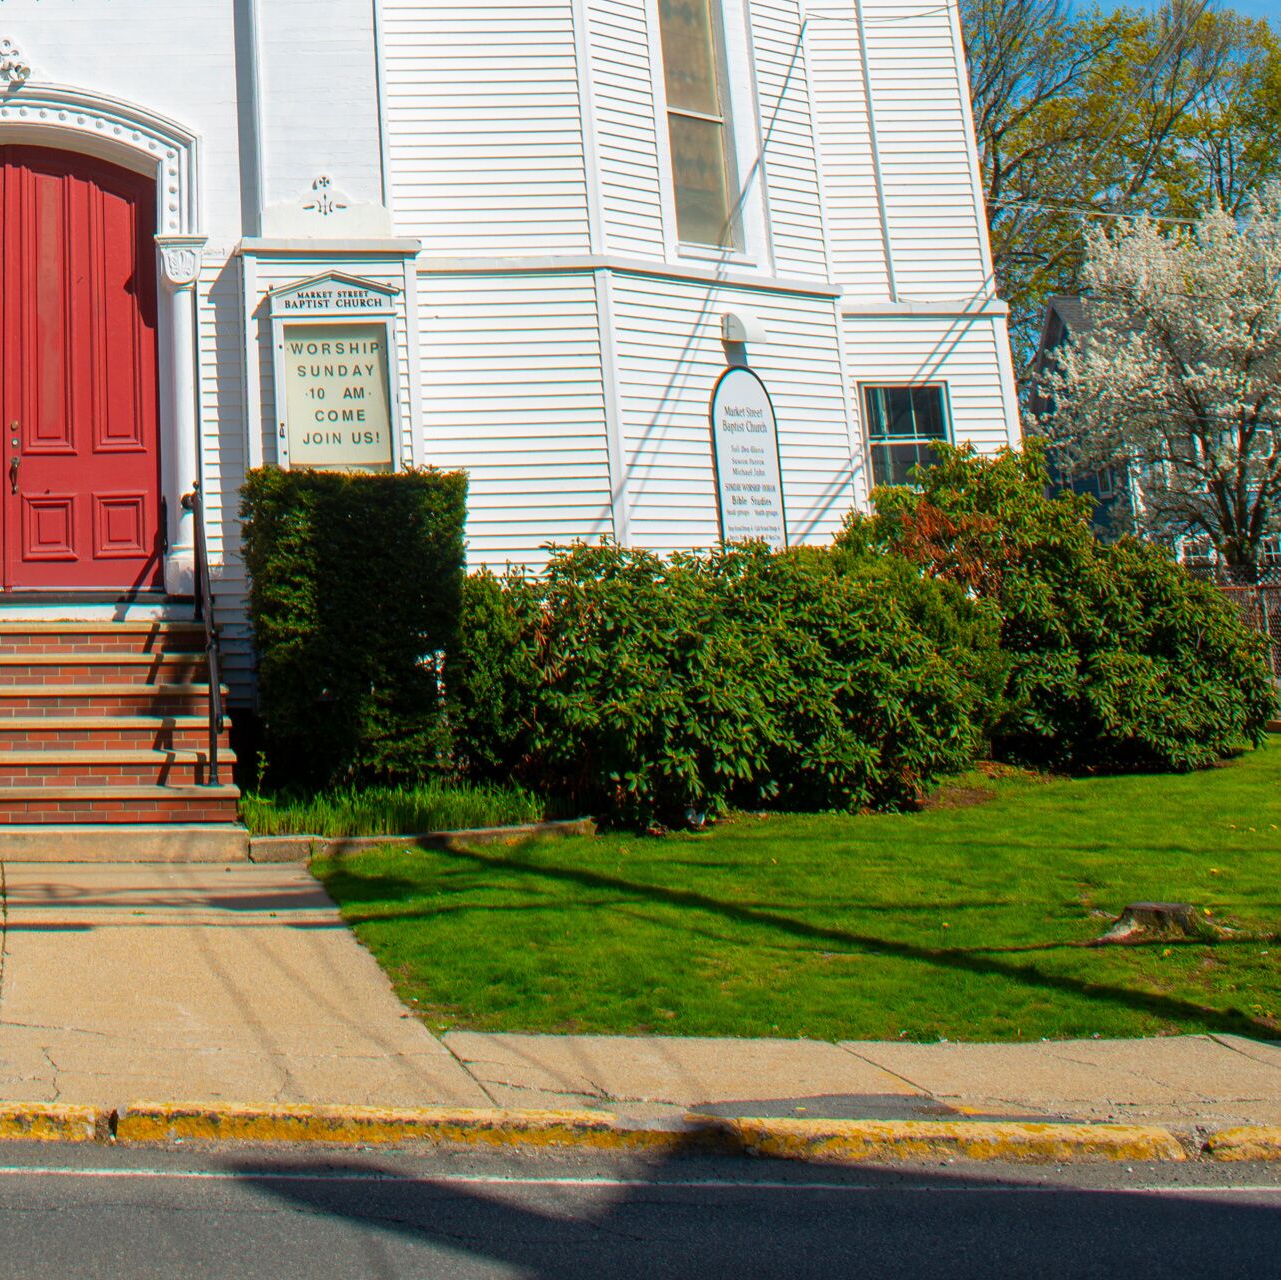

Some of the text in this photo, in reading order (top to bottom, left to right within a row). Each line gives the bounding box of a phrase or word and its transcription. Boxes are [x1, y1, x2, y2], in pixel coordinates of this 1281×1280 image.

[296, 290, 369, 299] MARKET STREET
[284, 298, 382, 309] BAPTIST CHURCH
[290, 342, 379, 355] WORSHIP
[297, 364, 374, 377] SUNDAY
[309, 387, 365, 400] 10 AM
[315, 409, 366, 422] COME
[724, 406, 763, 418] Market Street
[722, 419, 768, 434] Baptist Church
[302, 432, 380, 445] JOIN US!
[731, 495, 772, 506] Bible Studies
